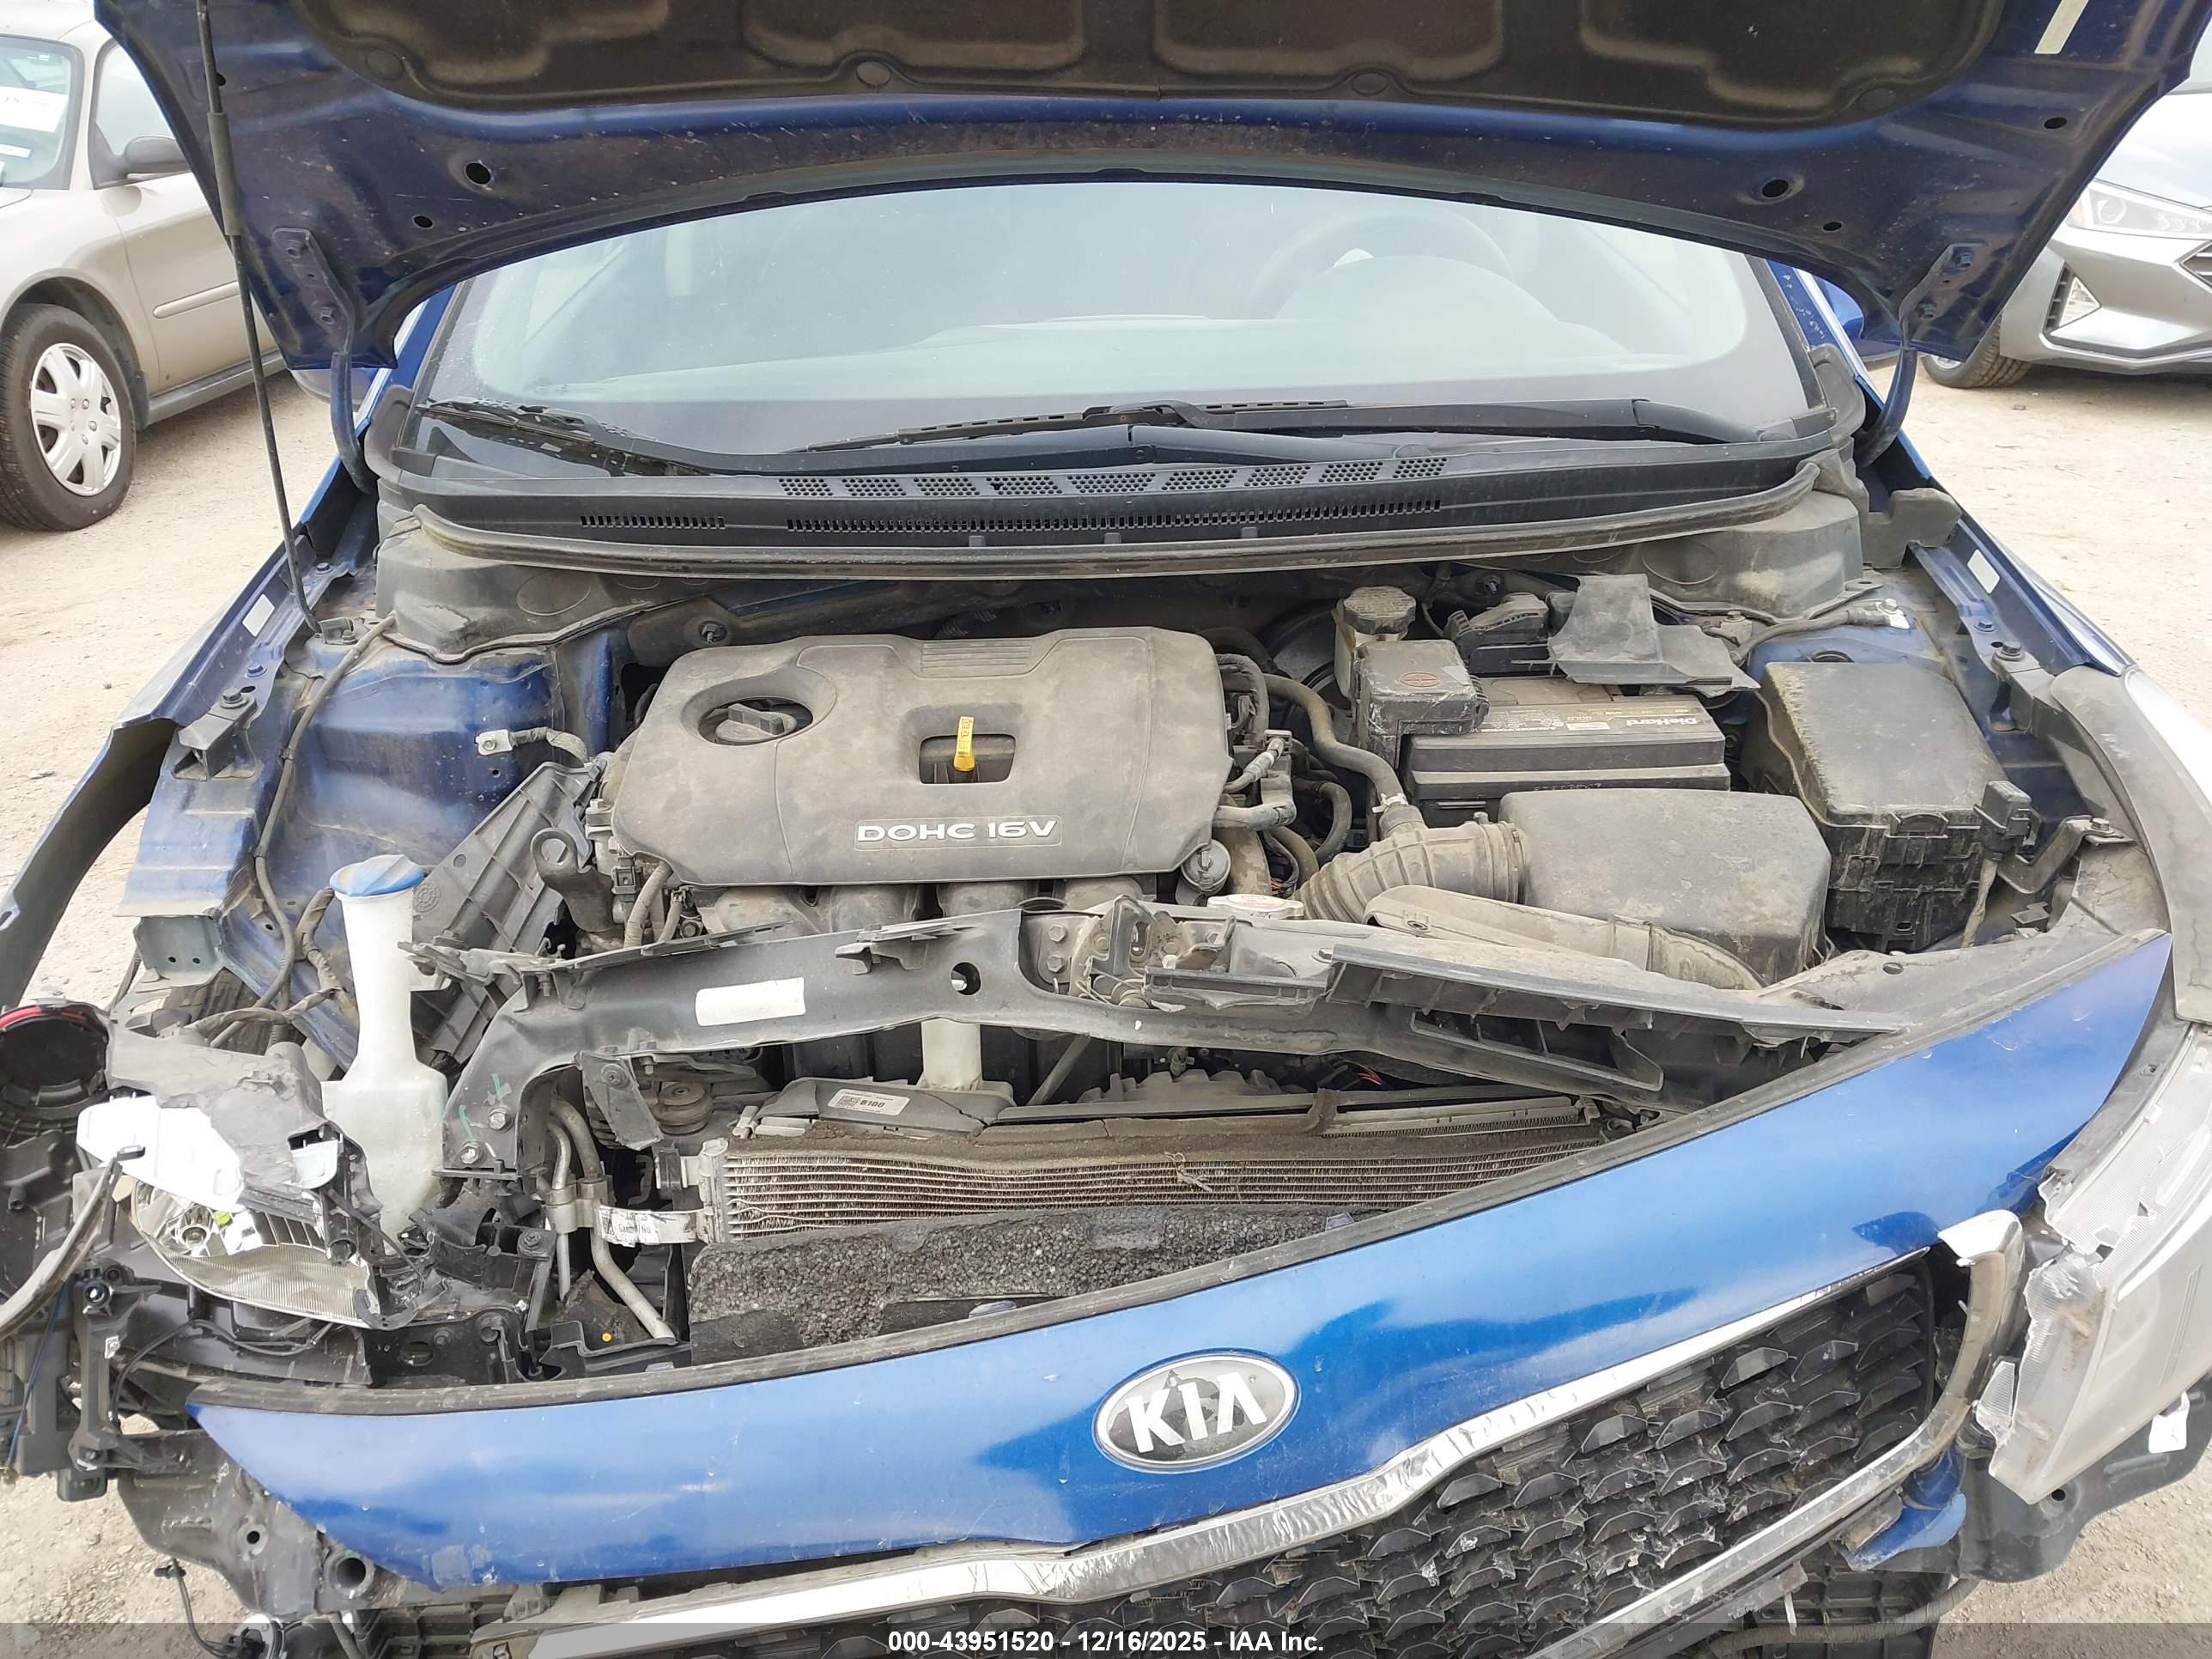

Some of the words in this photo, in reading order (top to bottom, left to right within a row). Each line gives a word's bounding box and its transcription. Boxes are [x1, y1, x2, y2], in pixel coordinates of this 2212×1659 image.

[1626, 716, 1698, 726] DieHard
[858, 823, 975, 842] DOHC
[988, 820, 1058, 839] 16V
[1125, 1371, 1267, 1454] KIA
